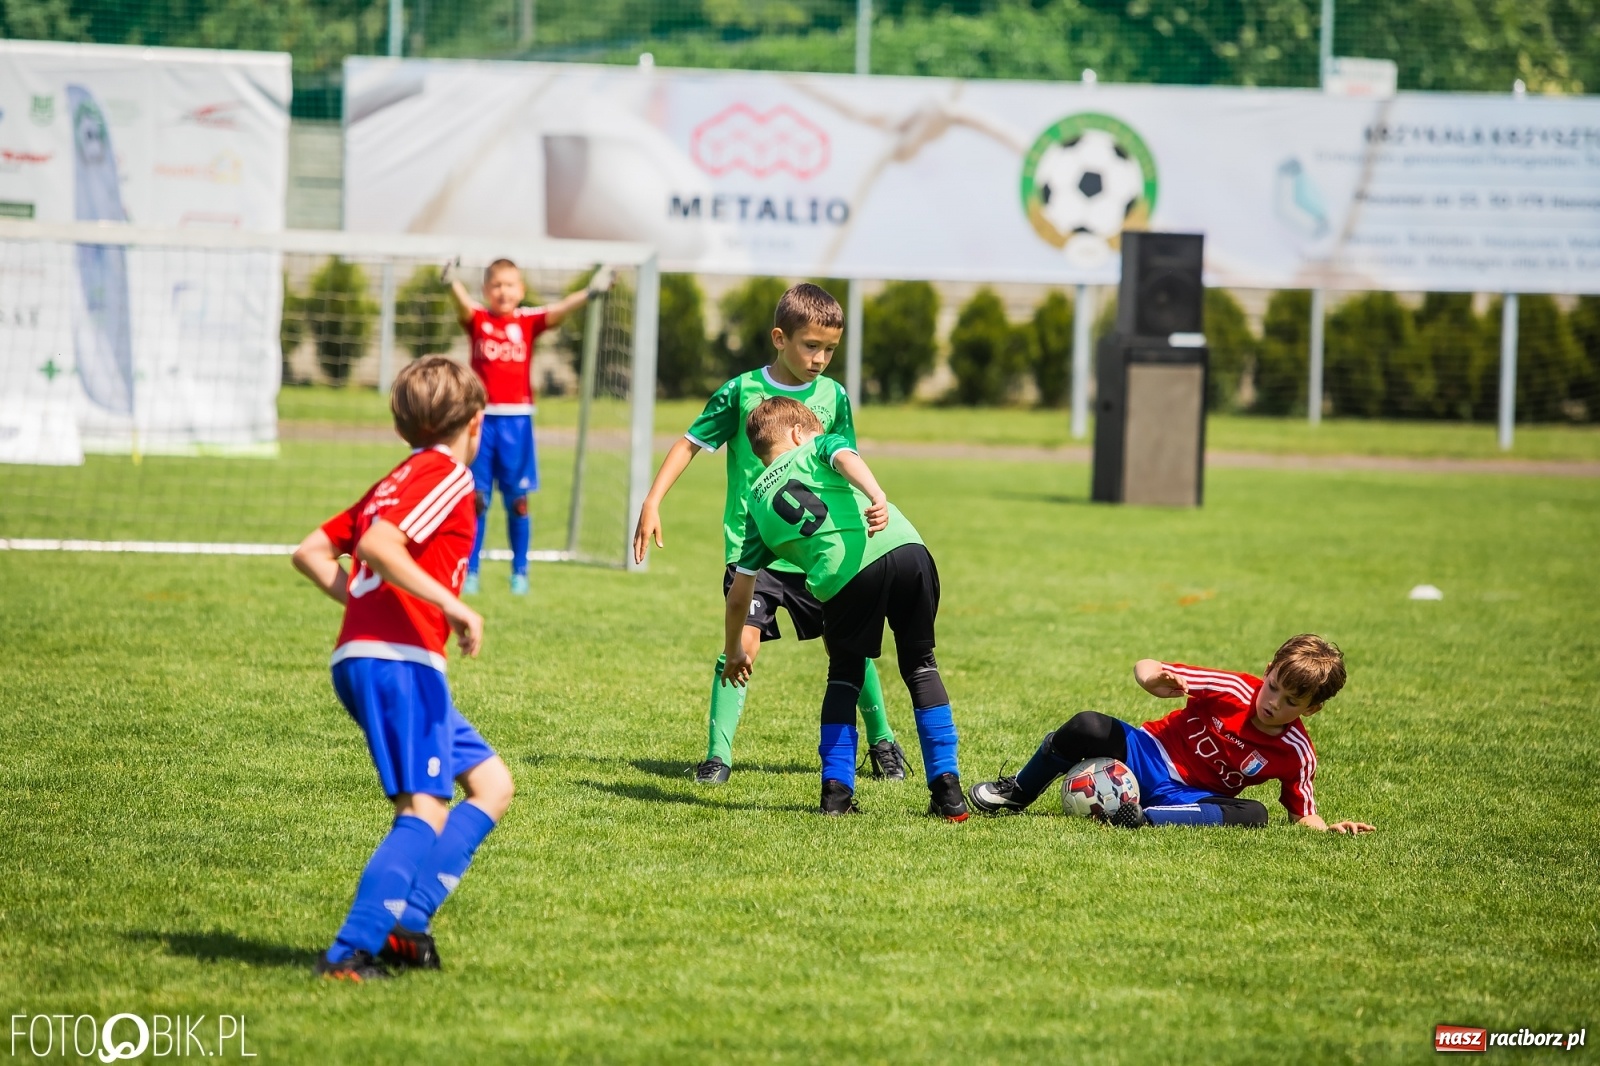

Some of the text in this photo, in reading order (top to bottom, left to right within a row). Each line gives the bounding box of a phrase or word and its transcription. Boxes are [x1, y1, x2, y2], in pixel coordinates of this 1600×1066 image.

[669, 196, 850, 226] METALIO
[772, 479, 829, 537] 9
[1225, 733, 1245, 750] AKWA
